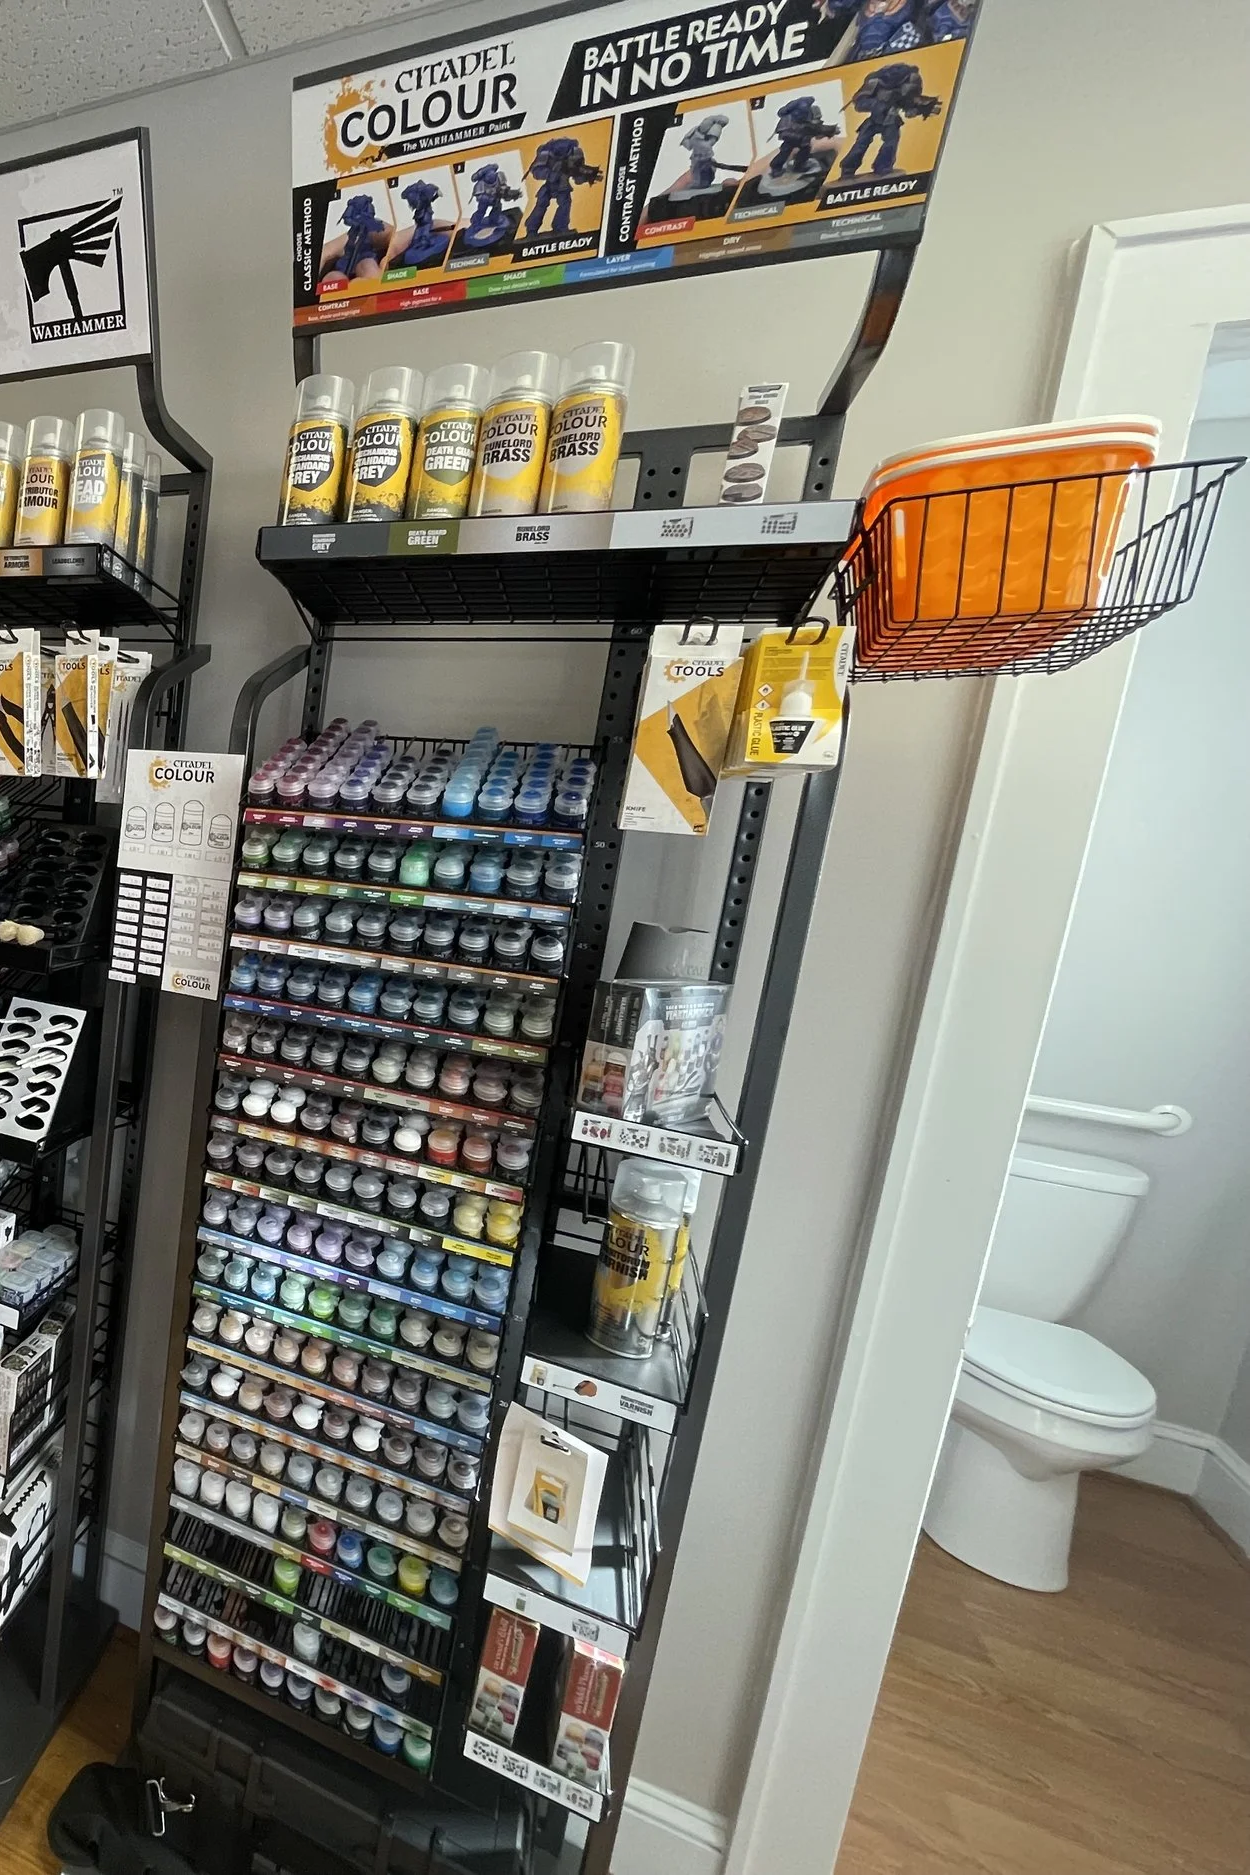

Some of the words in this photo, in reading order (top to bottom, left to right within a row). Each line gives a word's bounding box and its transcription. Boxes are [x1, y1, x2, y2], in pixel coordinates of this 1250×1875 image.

[584, 25, 683, 71] BATTLE
[686, 0, 789, 46] READY
[394, 42, 516, 94] CITADEL
[579, 65, 629, 107] IN
[630, 54, 692, 96] NO
[702, 21, 809, 78] TIME
[340, 73, 518, 149] COLOUR
[402, 141, 417, 152] The
[419, 128, 485, 150] WARHAMMER
[488, 120, 511, 134] Paint
[628, 116, 645, 170] METHOD
[615, 165, 626, 202] CHOOSE
[112, 188, 124, 196] TM
[826, 187, 872, 206] BATTLE
[873, 179, 918, 198] READY
[618, 171, 639, 243] CONTRAST
[734, 205, 779, 221] TECHNICAL
[303, 198, 312, 246] METHOD
[643, 221, 688, 236] CONTRAST
[831, 213, 882, 228] TECHNICAL
[522, 241, 557, 258] BATTLE
[558, 236, 593, 251] READY
[722, 235, 742, 246] DRY
[449, 258, 486, 269] TECHNICAL
[606, 254, 631, 265] LAYER
[303, 248, 312, 291] CLASSIC
[386, 271, 408, 281] SHADE
[502, 271, 527, 281] SHADE
[322, 282, 339, 292] BASE
[412, 287, 430, 296] BASE
[317, 300, 350, 312] CONTRAST
[31, 314, 126, 341] WARHAMMER
[484, 438, 532, 453] RUNELORD
[549, 442, 599, 464] BRASS
[354, 456, 397, 468] STANDARD
[424, 456, 470, 473] GREEN
[482, 448, 530, 466] BRASS
[77, 479, 105, 496] EAD
[407, 536, 439, 546] GREEN
[515, 532, 550, 542] BRASS
[311, 543, 331, 551] GREY
[3, 561, 30, 569] ARMOUR
[62, 662, 86, 671] TOOLS
[674, 665, 725, 678] TOOLS
[752, 711, 764, 737] PLASTIC
[749, 737, 762, 756] GLUE
[172, 759, 214, 770] CITADEL
[154, 767, 215, 784] COLOUR
[175, 977, 211, 991] COLOUR
[619, 1400, 654, 1417] VARNISH
